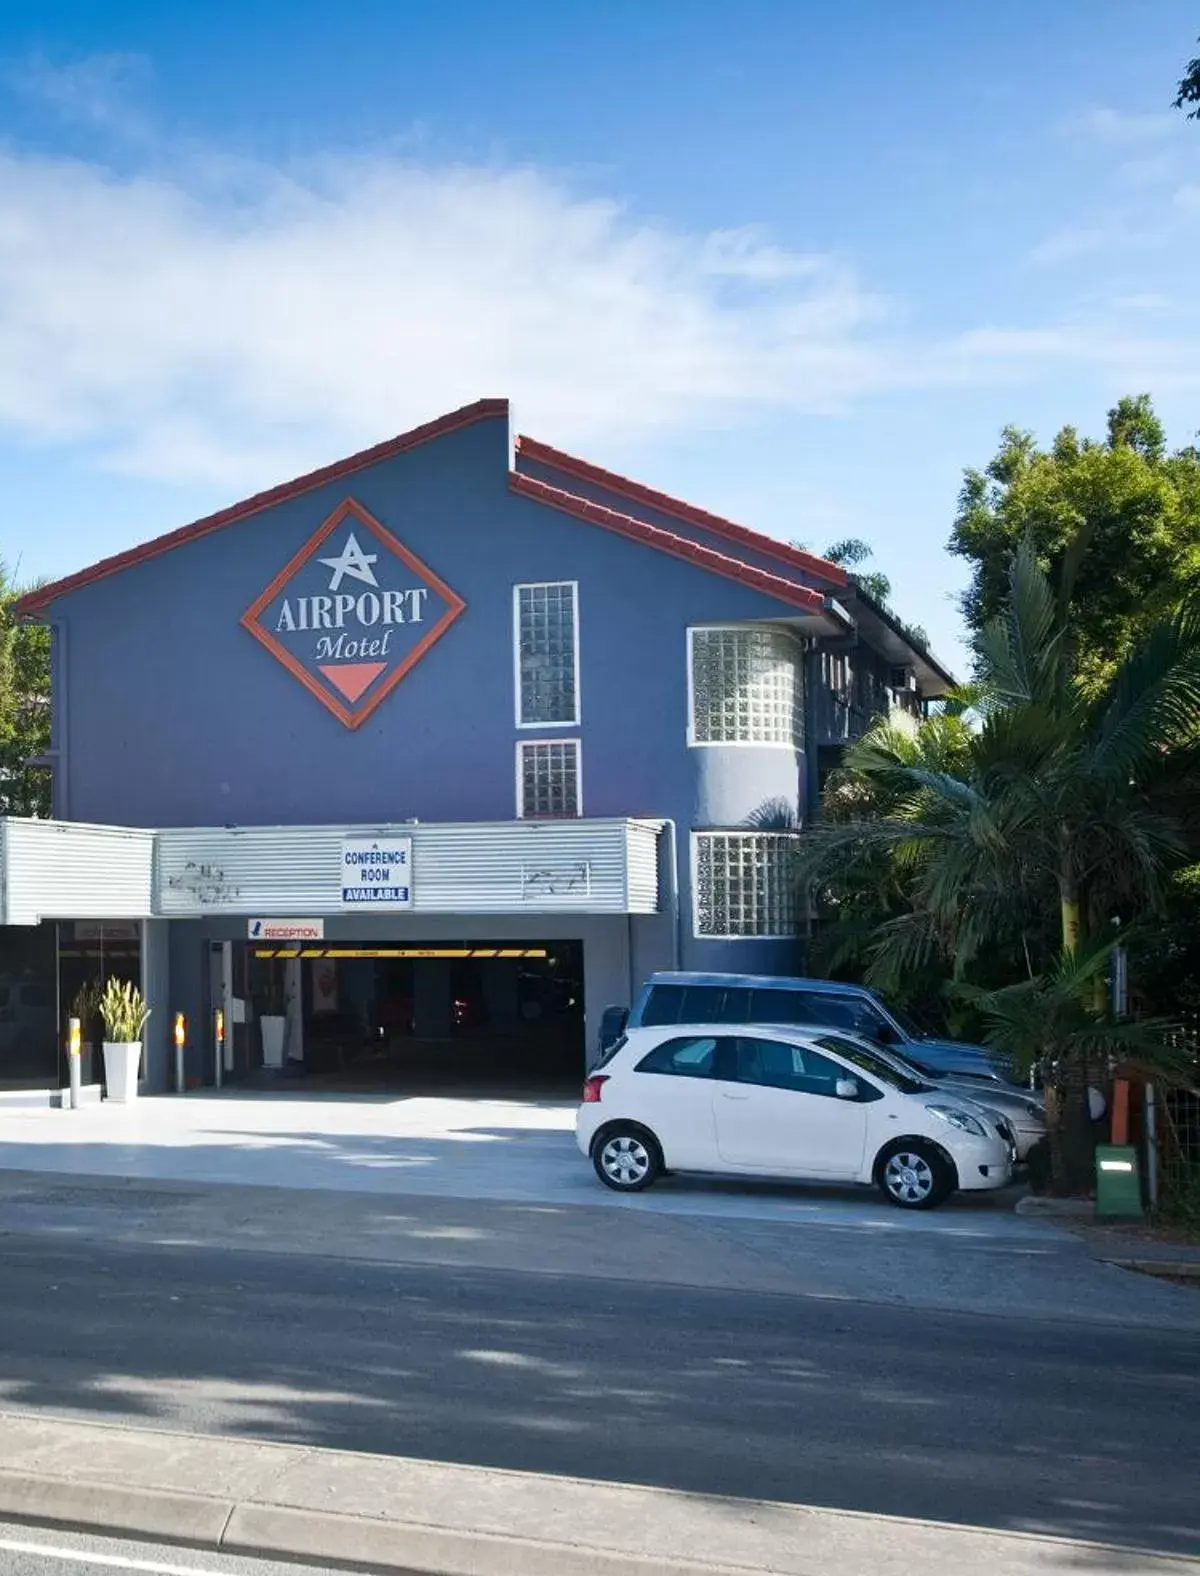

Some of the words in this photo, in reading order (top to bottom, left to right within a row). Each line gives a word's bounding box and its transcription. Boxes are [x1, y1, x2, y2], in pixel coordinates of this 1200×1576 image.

[275, 588, 428, 632] AIRPORT
[315, 630, 394, 660] Motel
[344, 851, 406, 865] CONFERENCE
[360, 868, 390, 882] ROOM
[345, 888, 406, 900] AVAILABLE
[264, 927, 318, 937] RECEPTION
